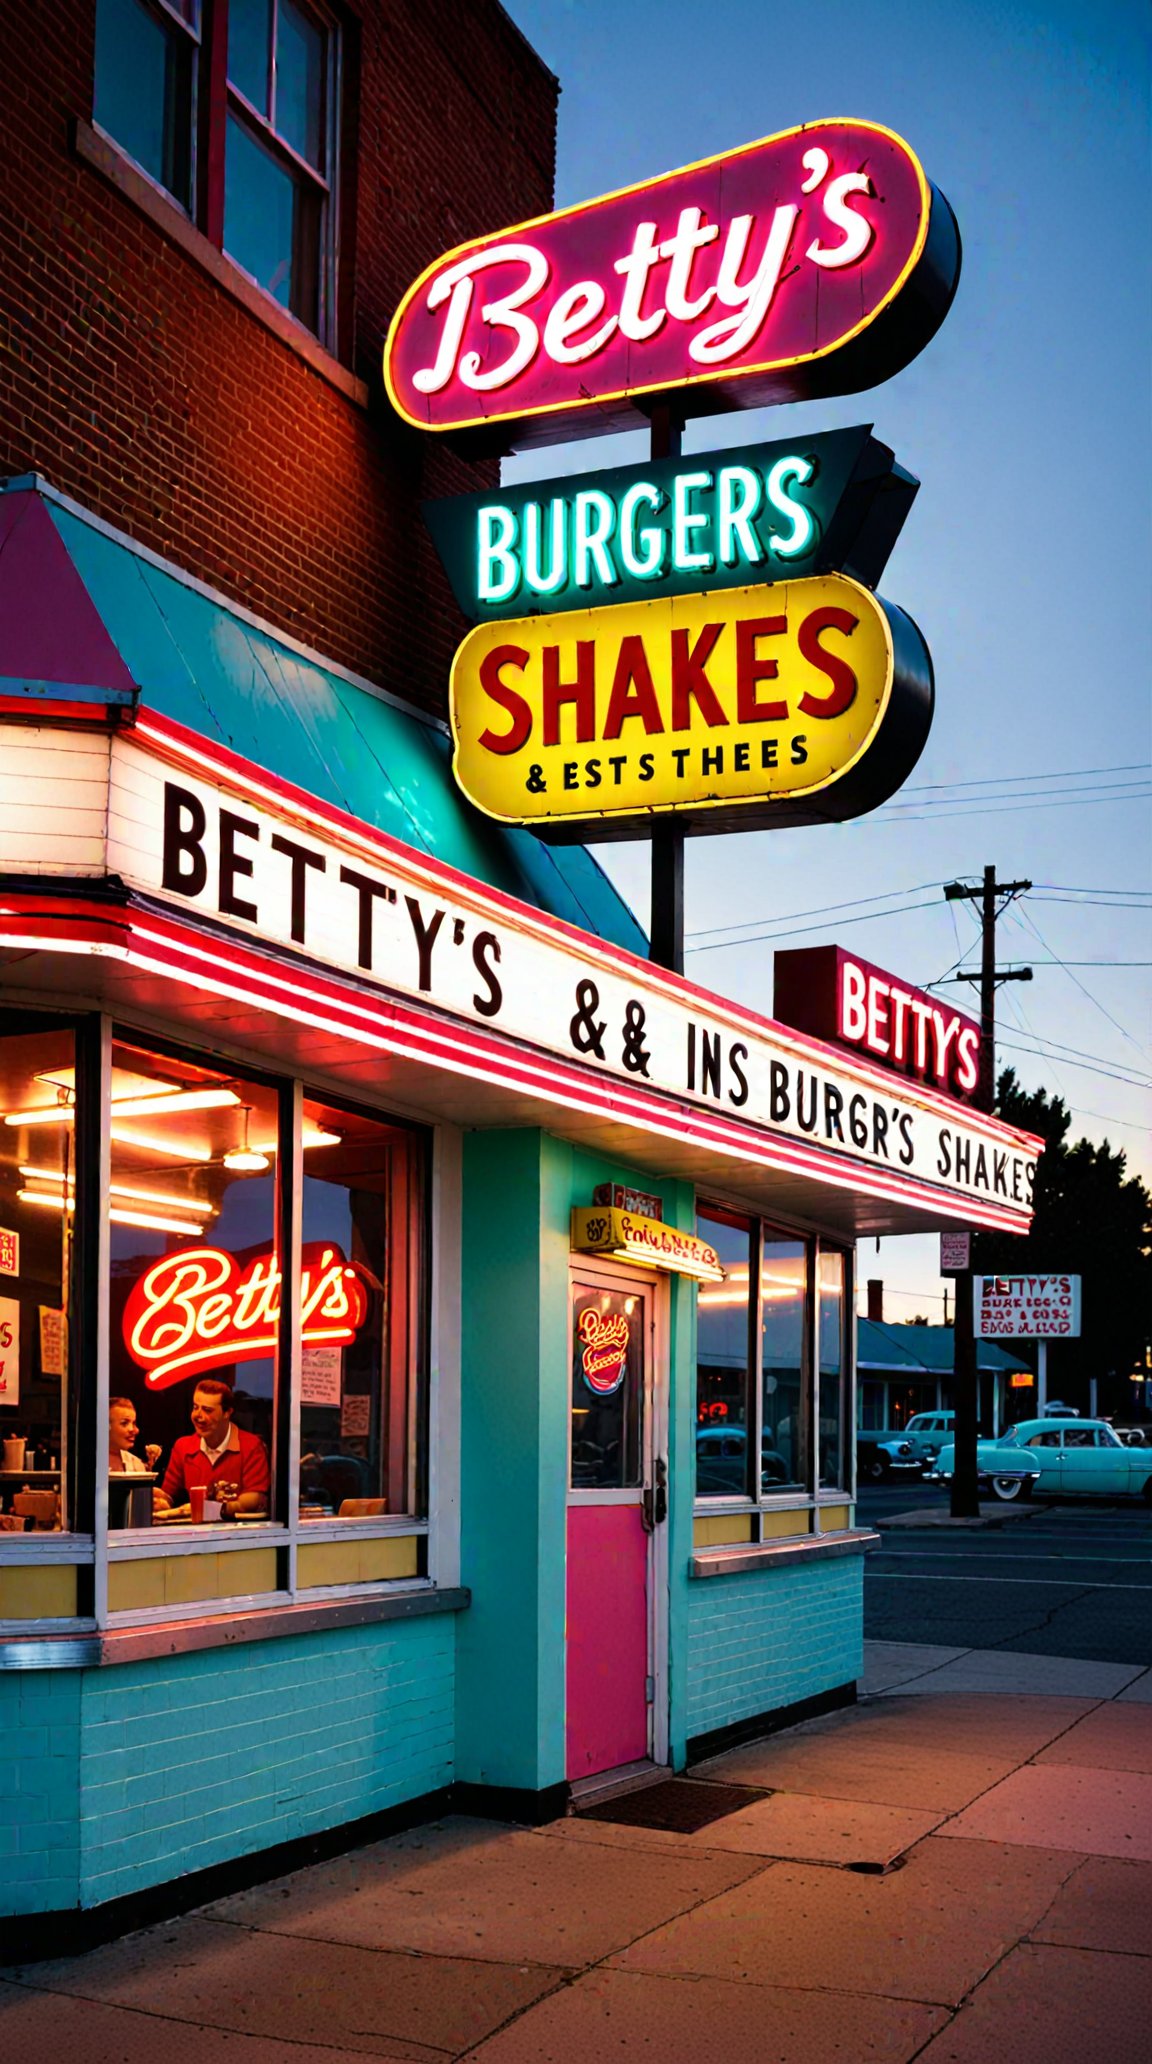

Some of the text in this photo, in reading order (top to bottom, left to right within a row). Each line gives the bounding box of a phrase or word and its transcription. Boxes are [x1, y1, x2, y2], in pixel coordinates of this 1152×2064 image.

[412, 147, 873, 393] Betty's
[477, 456, 815, 602] BURGERS
[478, 606, 860, 755] SHAKES
[526, 763, 547, 793] &
[162, 781, 503, 1017] BETTY'S
[687, 1022, 748, 1107] INS
[843, 961, 979, 1089] BETTY'S
[131, 1249, 356, 1358] Betty's
